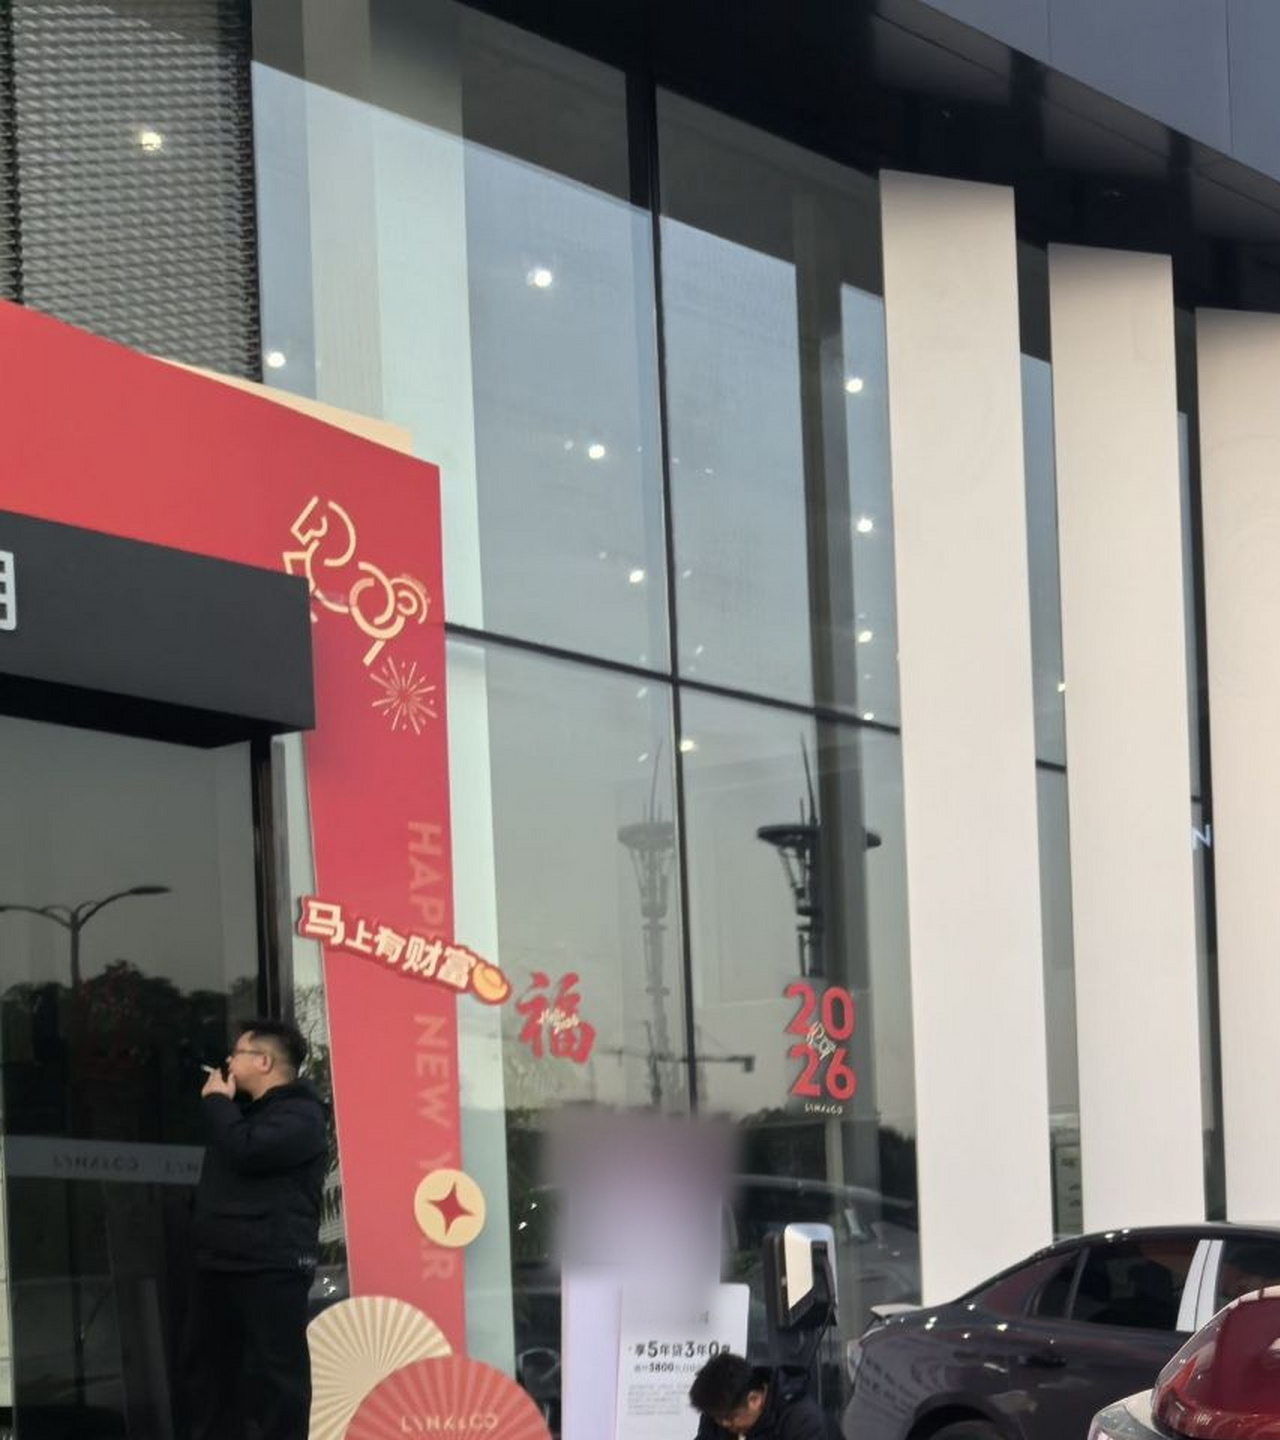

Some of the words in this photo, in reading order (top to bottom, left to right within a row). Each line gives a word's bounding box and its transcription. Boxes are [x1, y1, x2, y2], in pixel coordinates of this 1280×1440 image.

[305, 900, 476, 989] 马上有财富
[516, 971, 596, 1065] 福
[414, 1014, 451, 1129] NEW
[419, 1152, 457, 1282] YR
